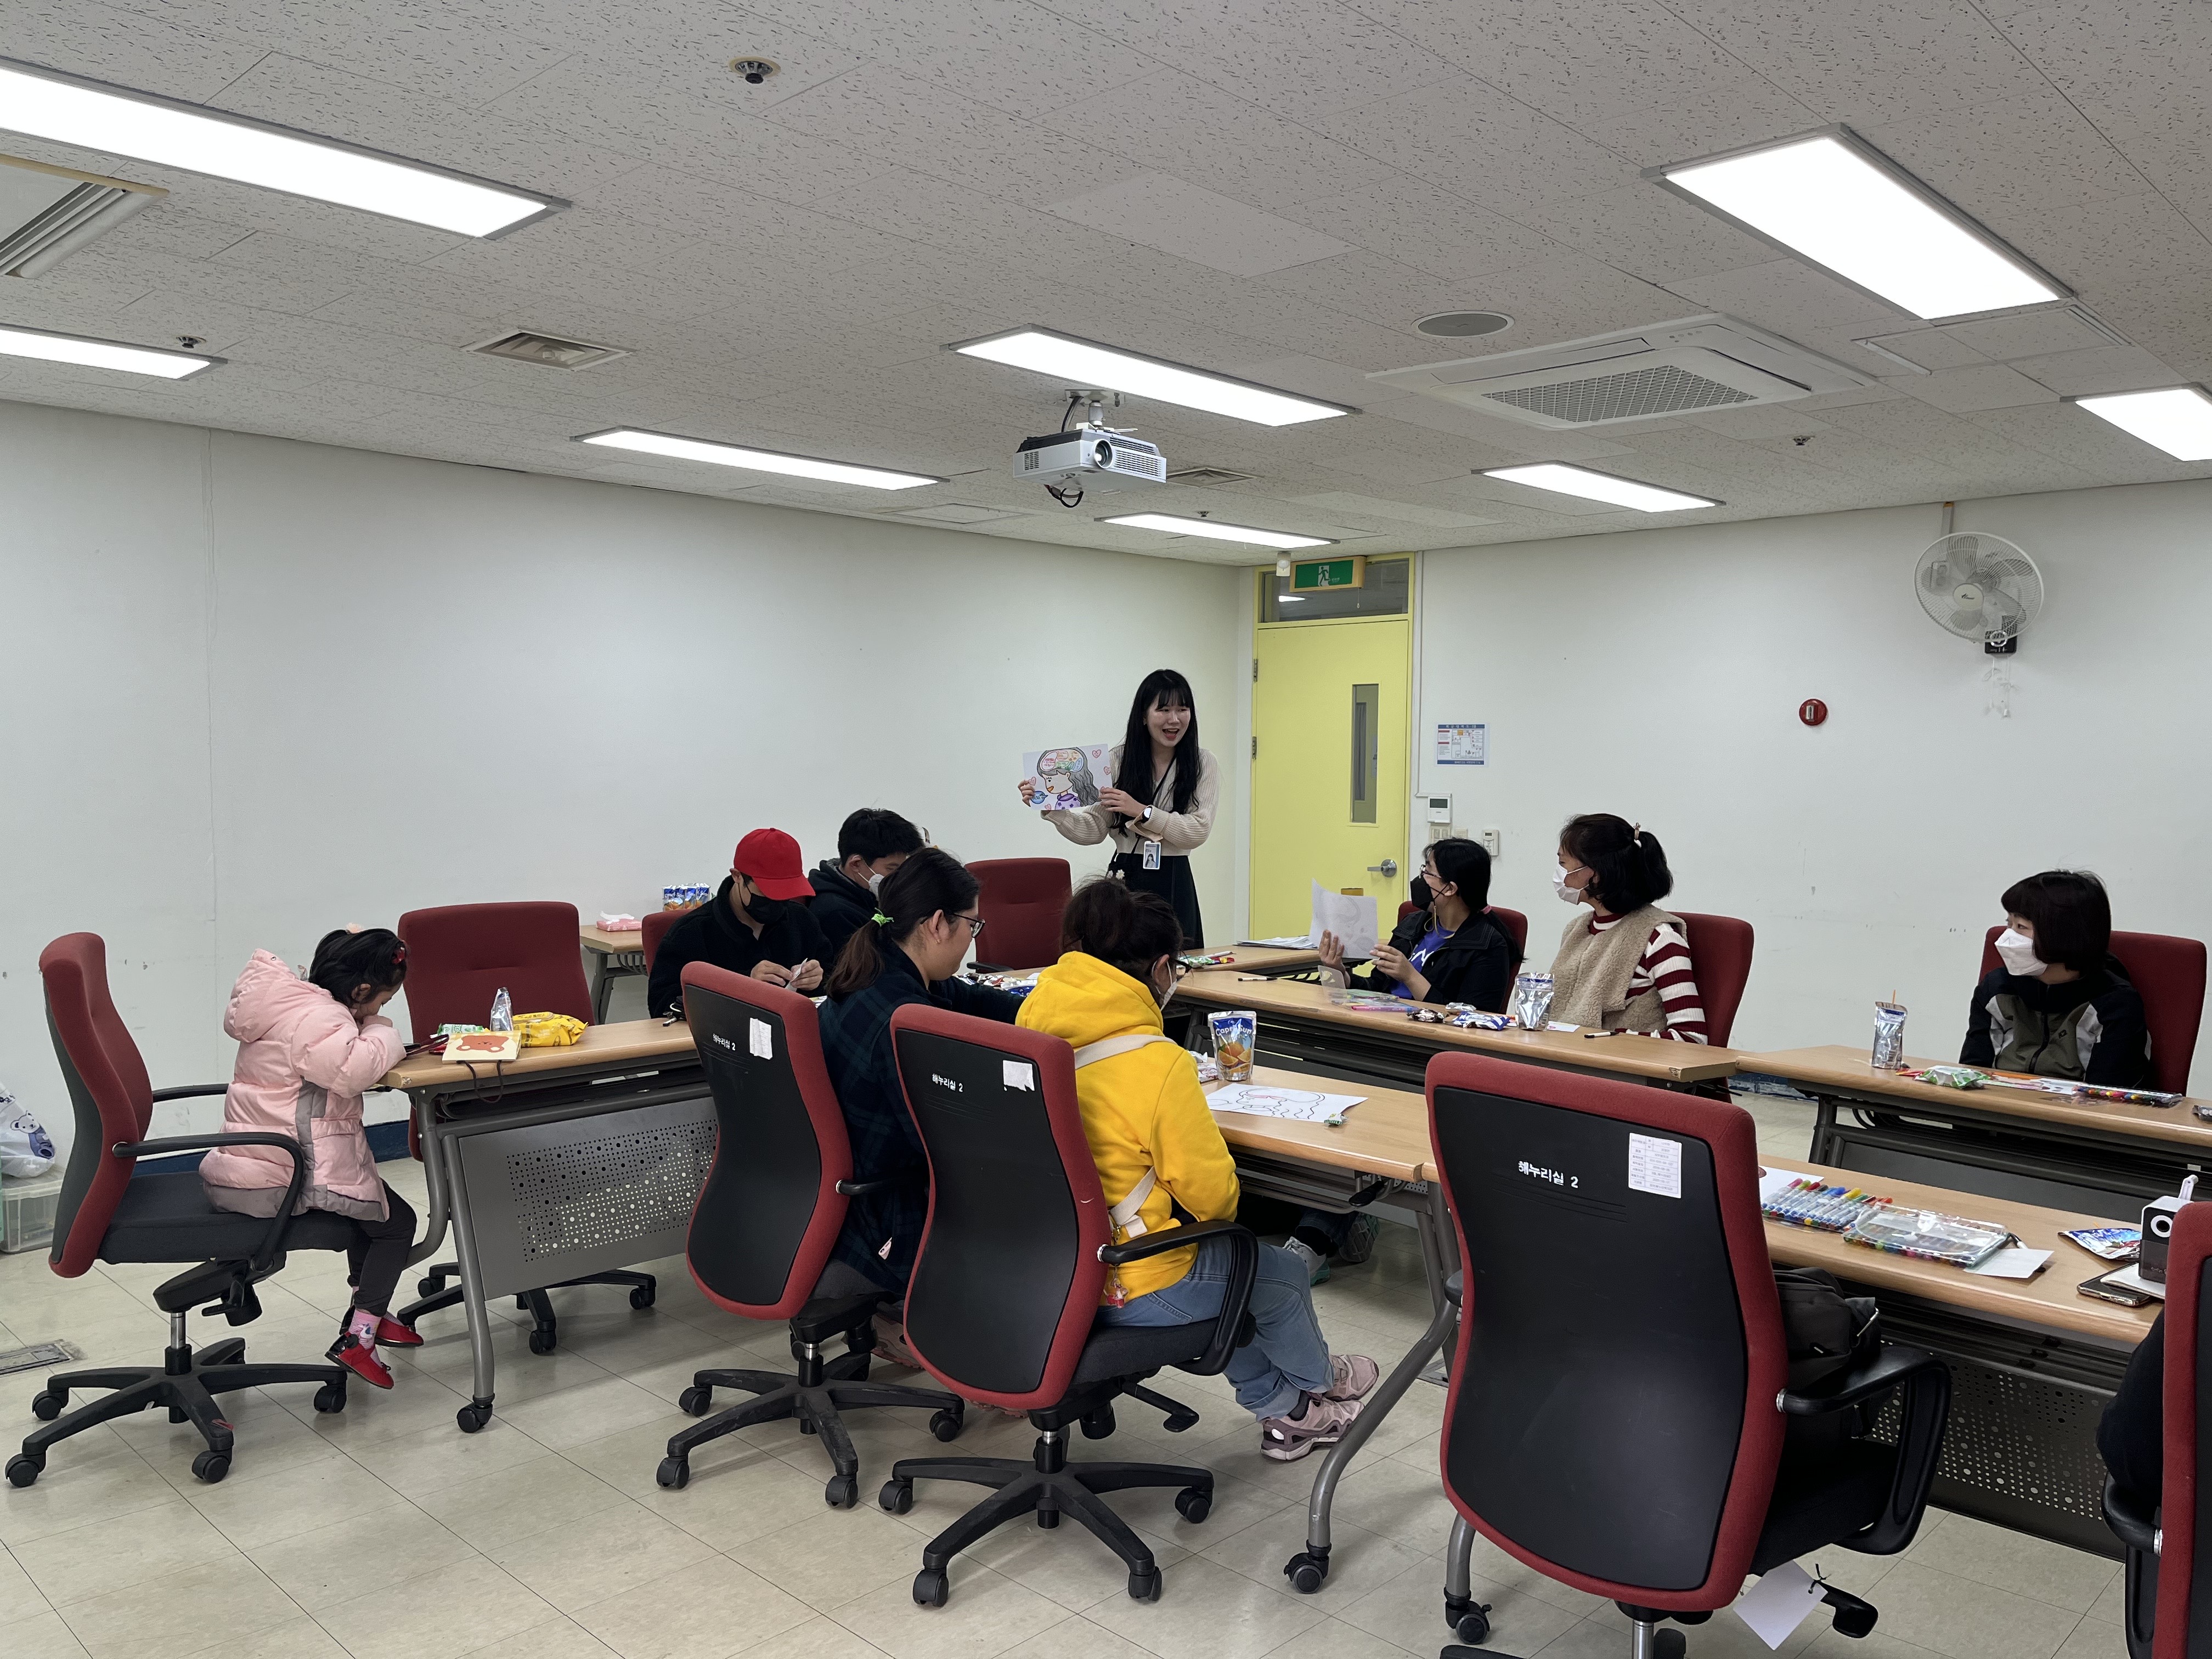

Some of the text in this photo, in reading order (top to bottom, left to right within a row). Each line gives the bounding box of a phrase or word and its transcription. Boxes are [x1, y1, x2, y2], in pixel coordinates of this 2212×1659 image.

[713, 1033, 736, 1051] 해누리실 2
[932, 1073, 963, 1092] 해누리실 2
[1518, 1161, 1578, 1188] 해누리실 2
